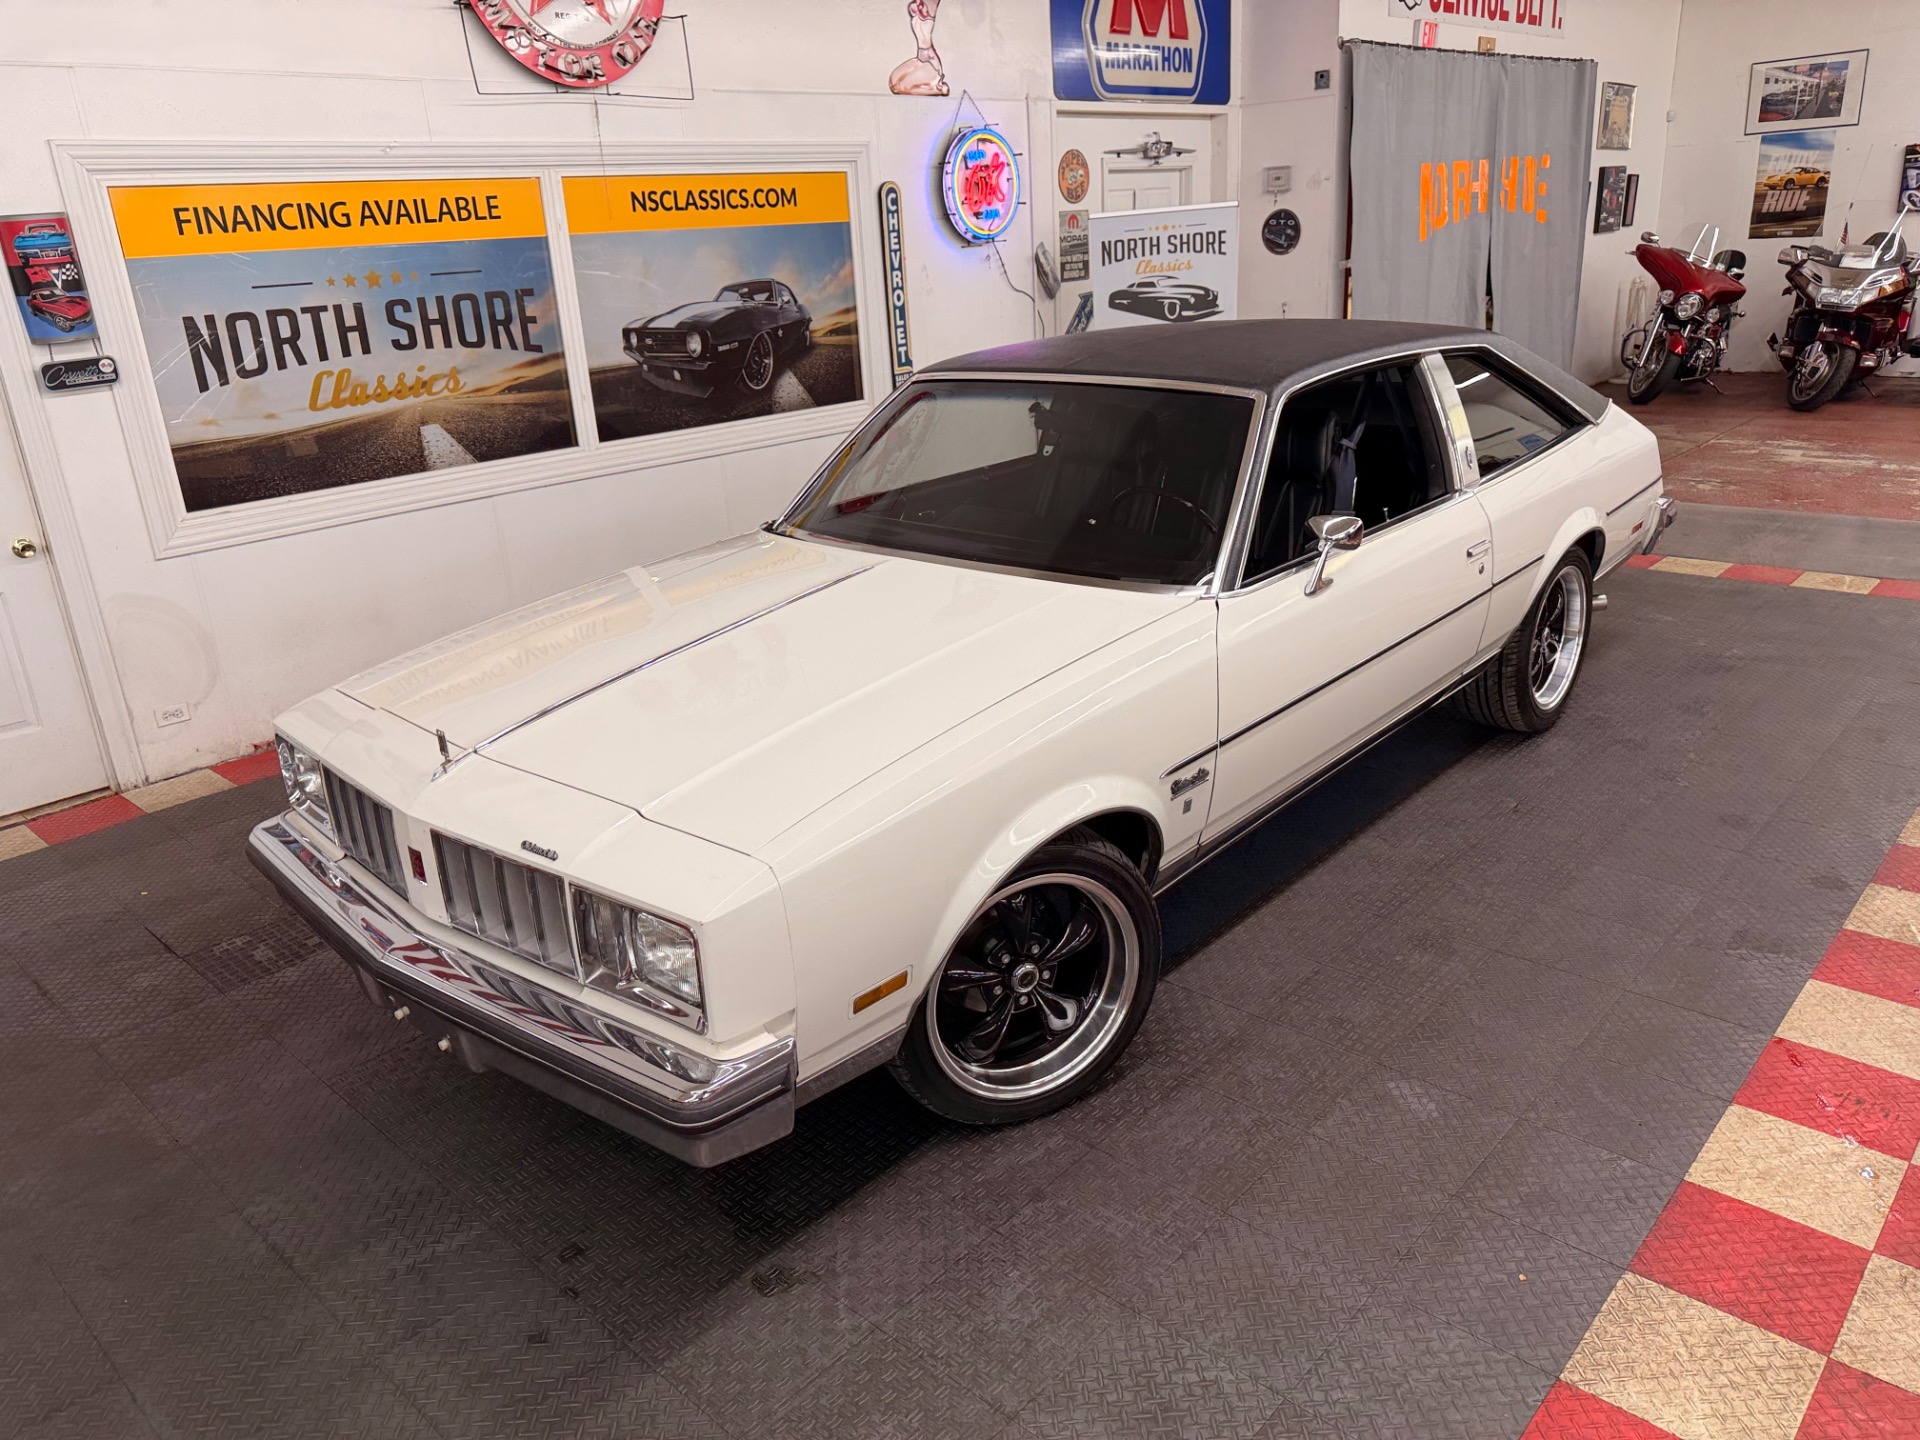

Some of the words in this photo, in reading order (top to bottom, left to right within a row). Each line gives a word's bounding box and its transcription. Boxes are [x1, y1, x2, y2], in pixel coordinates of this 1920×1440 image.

[1105, 41, 1194, 74] MARATHON
[1060, 151, 1087, 181] SUPER
[630, 187, 798, 213] NSCLASSICS.COM
[1066, 180, 1086, 201] BEE
[1761, 188, 1810, 213] RIDE
[173, 201, 352, 236] FINANCING
[360, 195, 502, 227] AVAILABLE
[1060, 234, 1088, 244] MOPAR
[1101, 236, 1160, 267] NORTH
[1167, 230, 1227, 255] SHORE
[886, 192, 908, 363] CHEVROLET
[1135, 259, 1193, 275] Classics
[181, 302, 372, 394] NORTH
[385, 288, 544, 353] SHORE
[45, 365, 99, 387] Corvette
[308, 364, 467, 412] Classics
